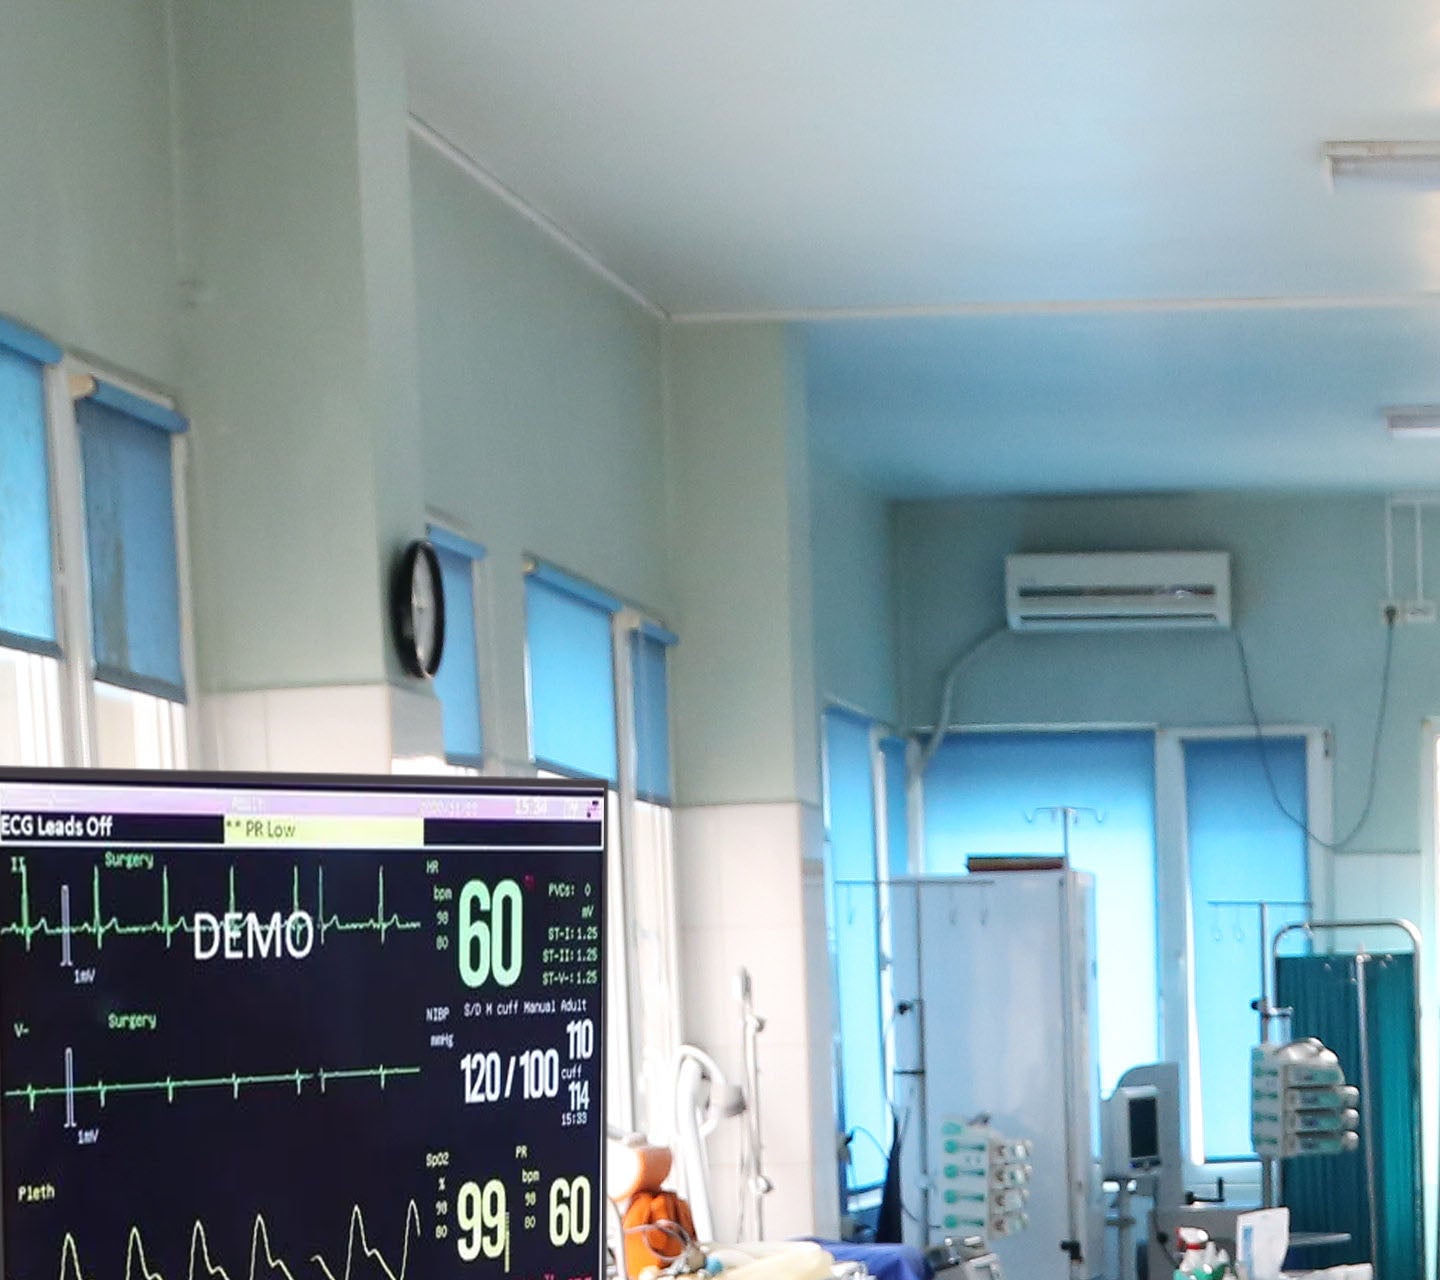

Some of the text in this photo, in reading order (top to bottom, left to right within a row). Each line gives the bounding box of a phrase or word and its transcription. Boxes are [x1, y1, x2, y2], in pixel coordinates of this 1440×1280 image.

[0, 814, 113, 837] ECG Leads Off
[245, 820, 263, 837] PR
[267, 822, 296, 838] Low
[105, 851, 154, 870] Surgery
[426, 860, 439, 874] HR
[433, 885, 453, 902] bpm
[584, 882, 592, 897] 0
[194, 910, 314, 960] DEMO
[459, 878, 523, 989] 60
[426, 1006, 450, 1022] NIBP
[496, 999, 518, 1016] cuff
[523, 999, 556, 1014] Manual
[560, 998, 587, 1012] Adult
[108, 1012, 157, 1031] Surgery
[430, 1033, 455, 1048] mmHg
[566, 1018, 594, 1060] 110
[561, 1063, 582, 1079] cuff
[568, 1080, 590, 1112] 114
[516, 1145, 528, 1159] PR
[522, 1169, 540, 1184] bpm
[18, 1183, 55, 1202] Pleth
[457, 1178, 506, 1262] 99
[549, 1175, 591, 1247] 60
